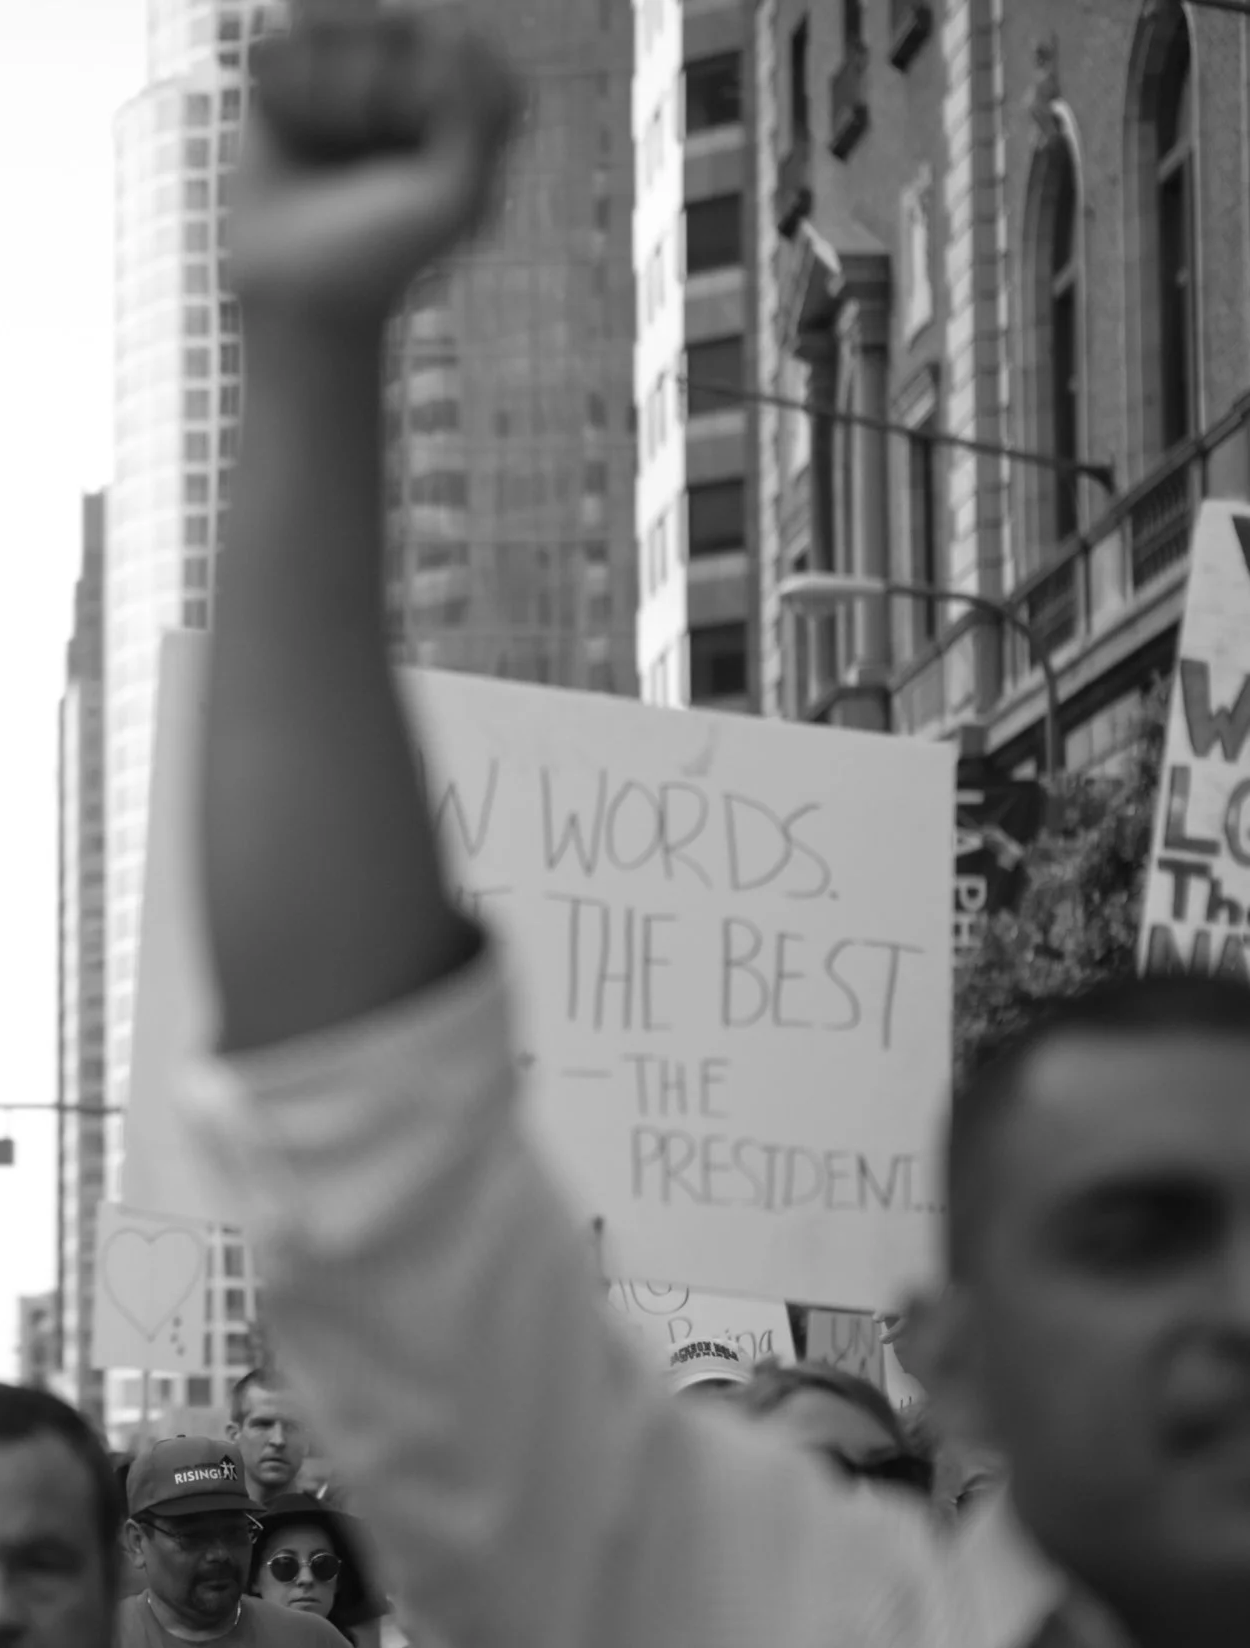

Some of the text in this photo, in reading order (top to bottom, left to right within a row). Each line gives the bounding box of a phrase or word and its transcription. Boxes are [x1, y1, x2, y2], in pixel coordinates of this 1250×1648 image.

[540, 766, 840, 901] WORDS.
[1157, 858, 1250, 926] Th
[544, 890, 927, 1052] THE BEST
[621, 1053, 731, 1119] THE
